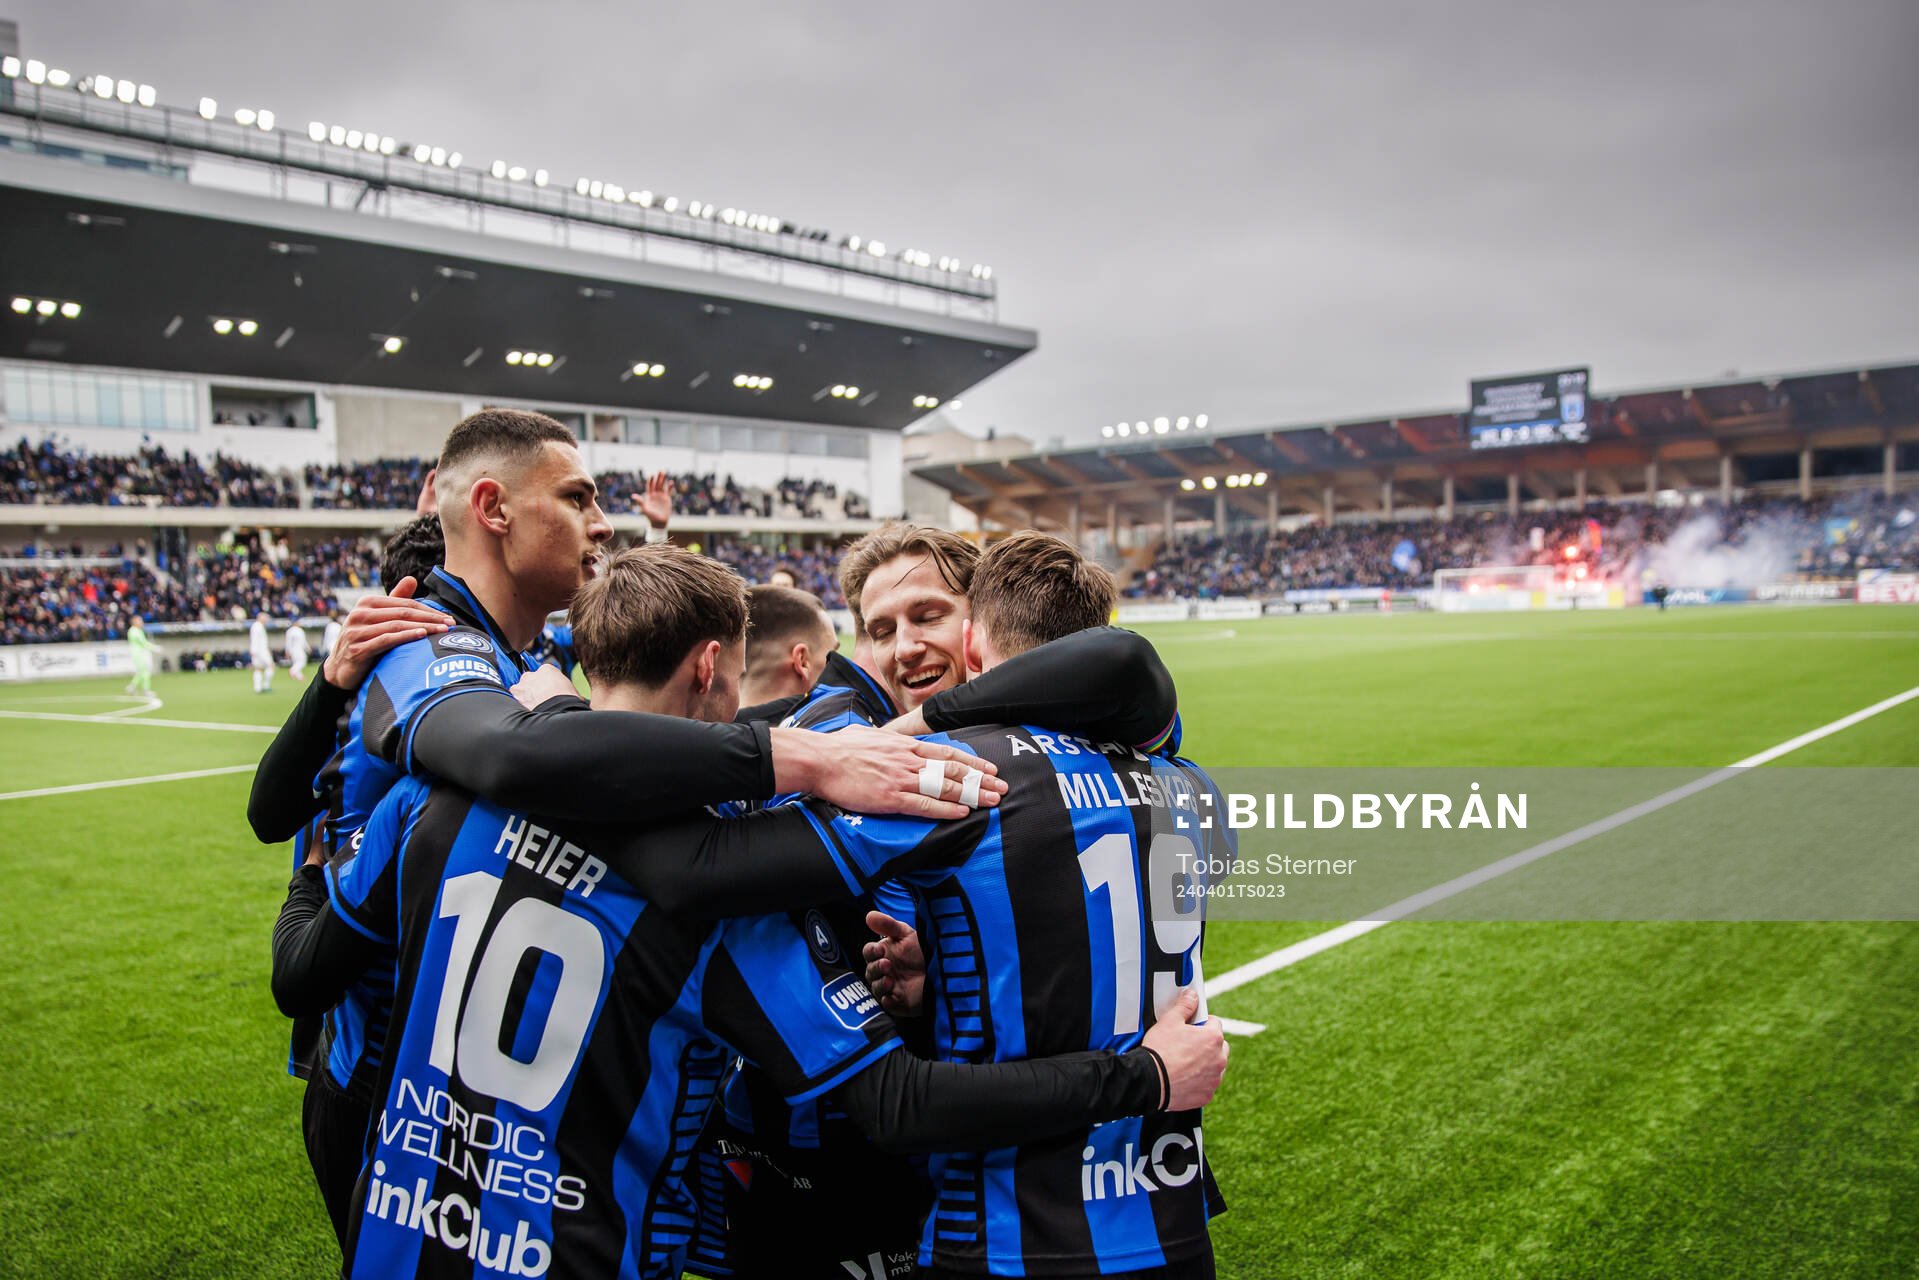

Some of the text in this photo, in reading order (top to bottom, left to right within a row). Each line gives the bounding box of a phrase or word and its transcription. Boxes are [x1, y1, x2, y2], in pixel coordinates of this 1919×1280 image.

[494, 814, 608, 898] HEIER
[429, 870, 605, 1112] 10
[1077, 833, 1209, 1036] 19
[396, 1078, 546, 1161] NORDIC
[366, 1159, 552, 1278] inkClub
